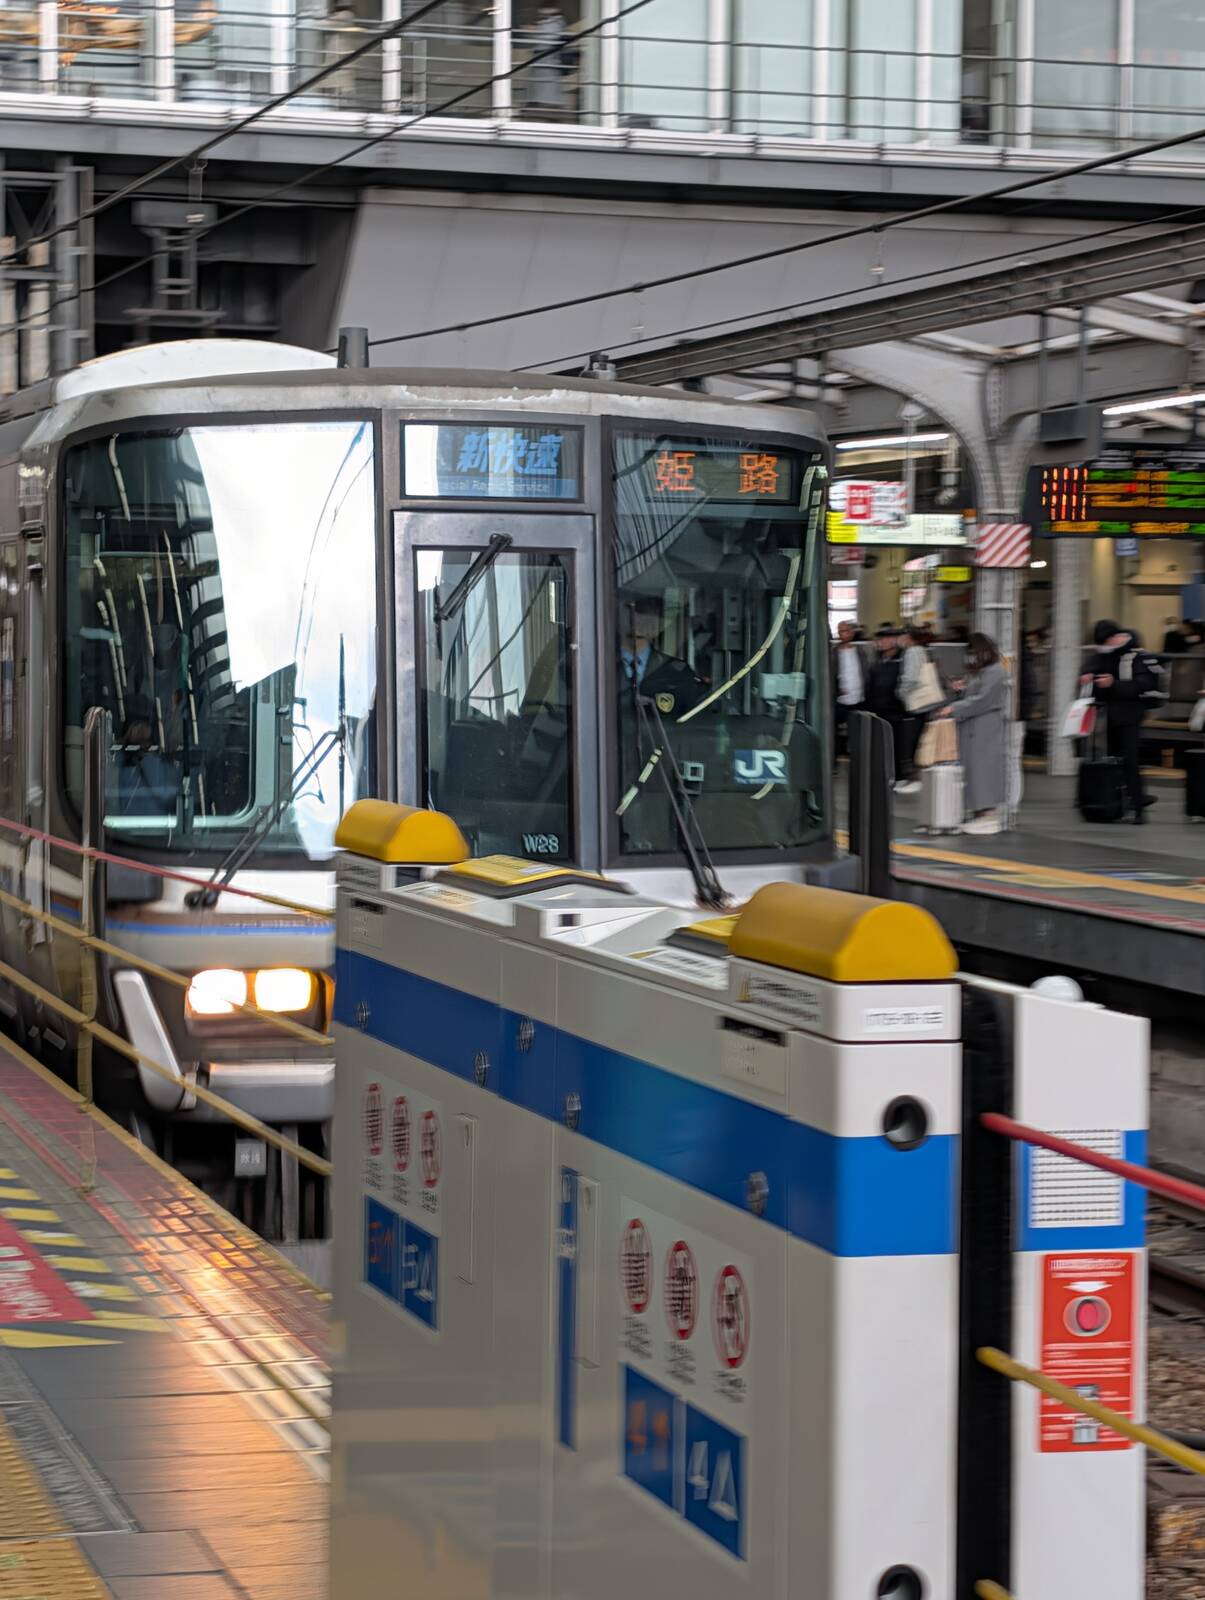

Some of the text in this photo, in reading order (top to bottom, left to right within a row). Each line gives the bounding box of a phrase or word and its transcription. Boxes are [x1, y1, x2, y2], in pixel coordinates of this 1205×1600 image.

[456, 431, 564, 474] 新快速
[734, 749, 787, 778] JR
[521, 832, 559, 854] W28
